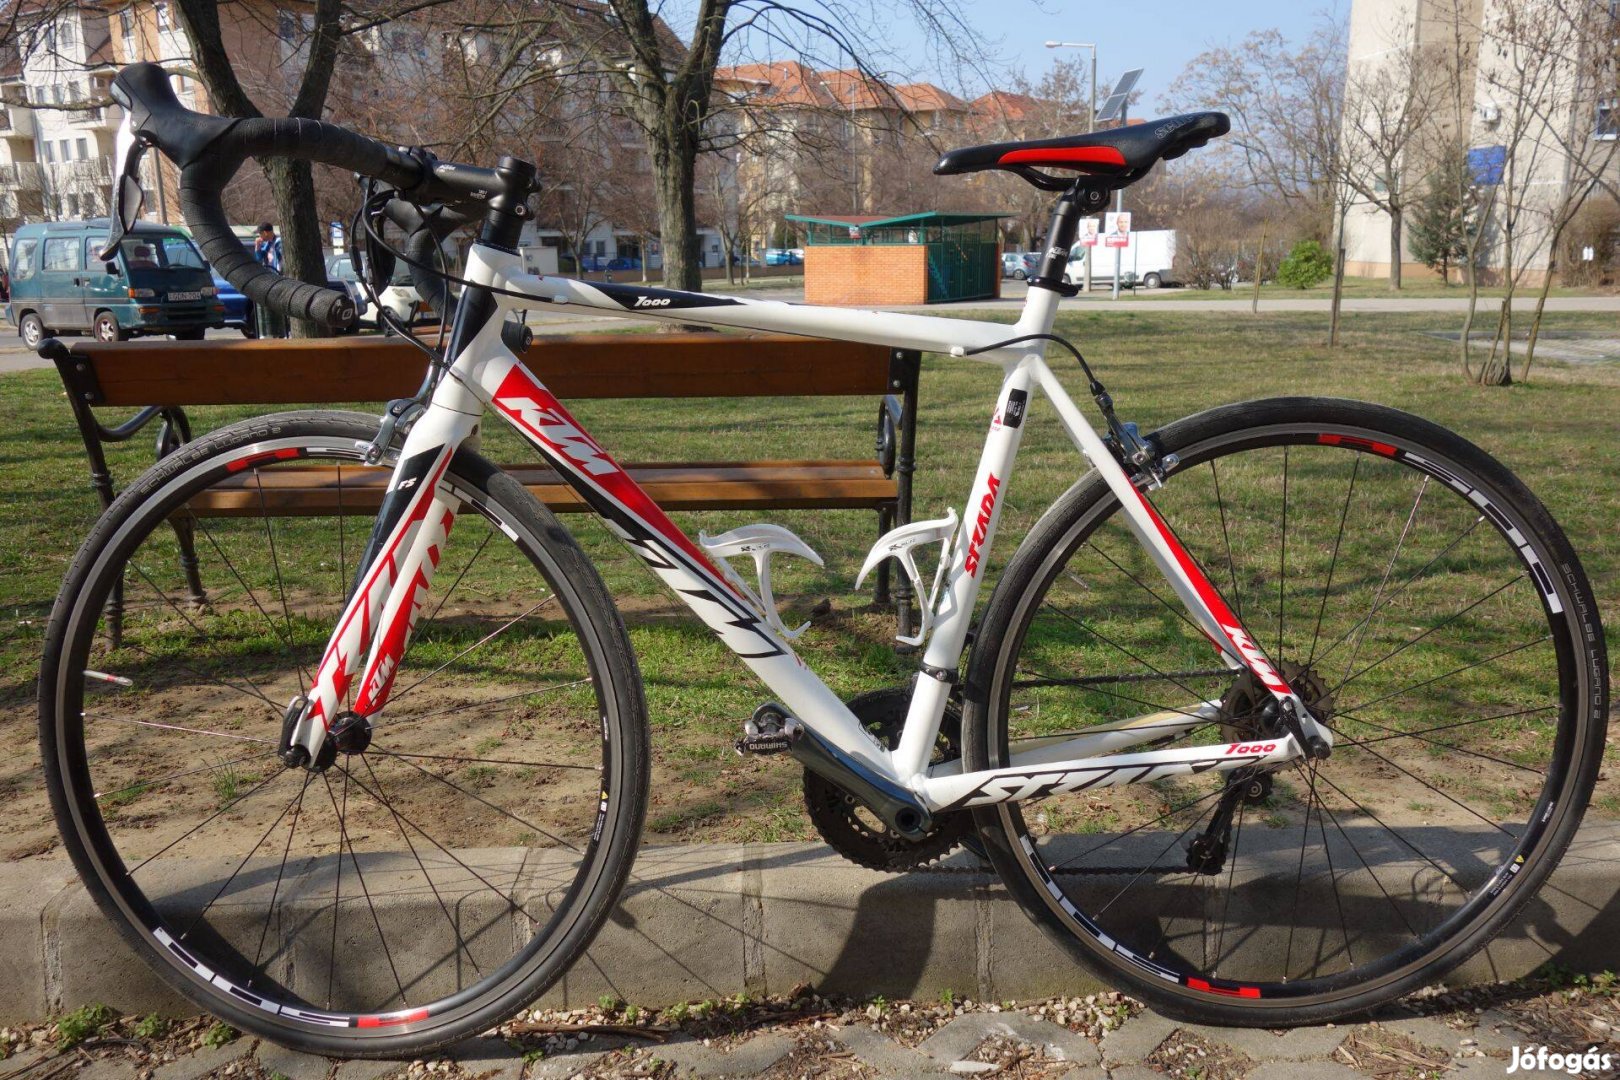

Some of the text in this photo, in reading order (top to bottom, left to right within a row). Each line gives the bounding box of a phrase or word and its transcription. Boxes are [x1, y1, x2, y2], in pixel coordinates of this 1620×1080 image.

[634, 296, 671, 307] 1000
[140, 426, 282, 494] SCHWALBE LUGANO 2
[497, 397, 620, 476] KTM
[964, 472, 1001, 579] STRADA
[1222, 624, 1284, 687] KTM
[1562, 562, 1596, 642] SCHWALBE
[1591, 649, 1602, 706] LUGANO
[368, 653, 394, 707] KTM
[750, 741, 788, 750] SHIMANO
[1225, 743, 1277, 755] 1000
